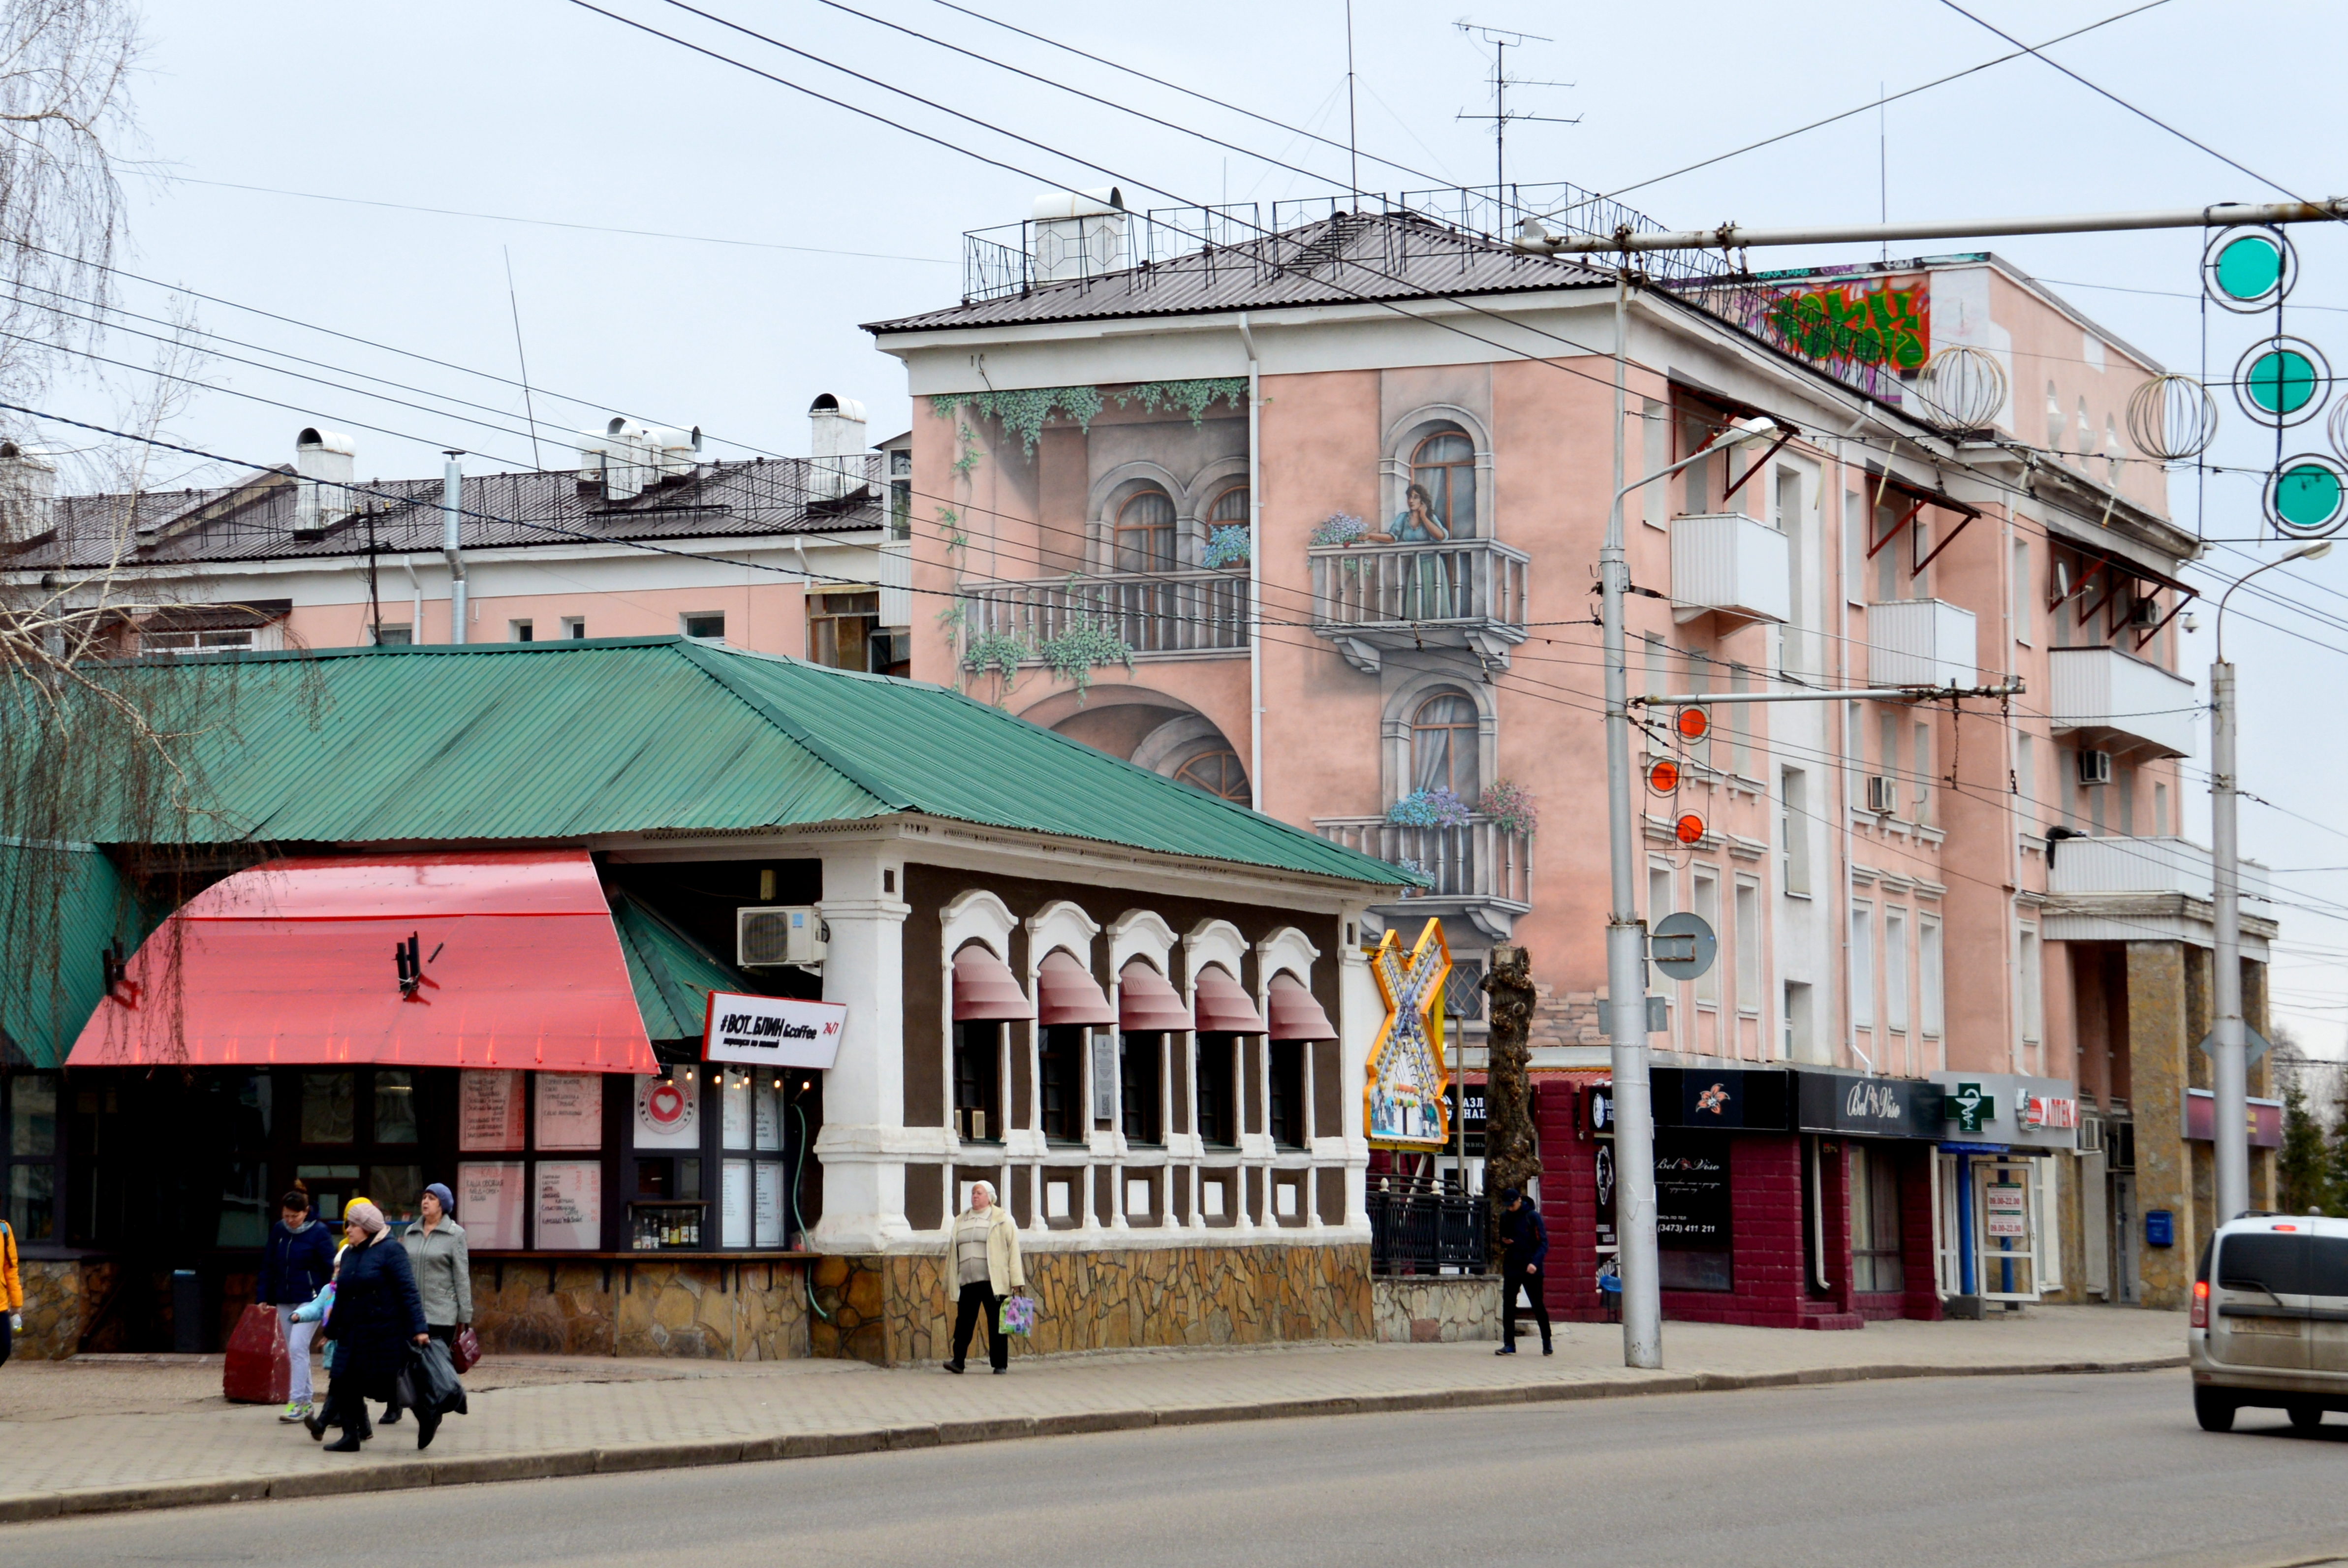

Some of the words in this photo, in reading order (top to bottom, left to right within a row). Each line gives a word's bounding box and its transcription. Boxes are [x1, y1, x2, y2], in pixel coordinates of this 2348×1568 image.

[720, 1014, 785, 1037] #ВОТ_БЛИН
[823, 1021, 839, 1036] 24/7
[1847, 1081, 1871, 1116] Bel
[1878, 1087, 1900, 1118] Viso
[1654, 1158, 1681, 1169] Bel
[1693, 1158, 1720, 1170] Viso
[1658, 1223, 1683, 1233] (3473)
